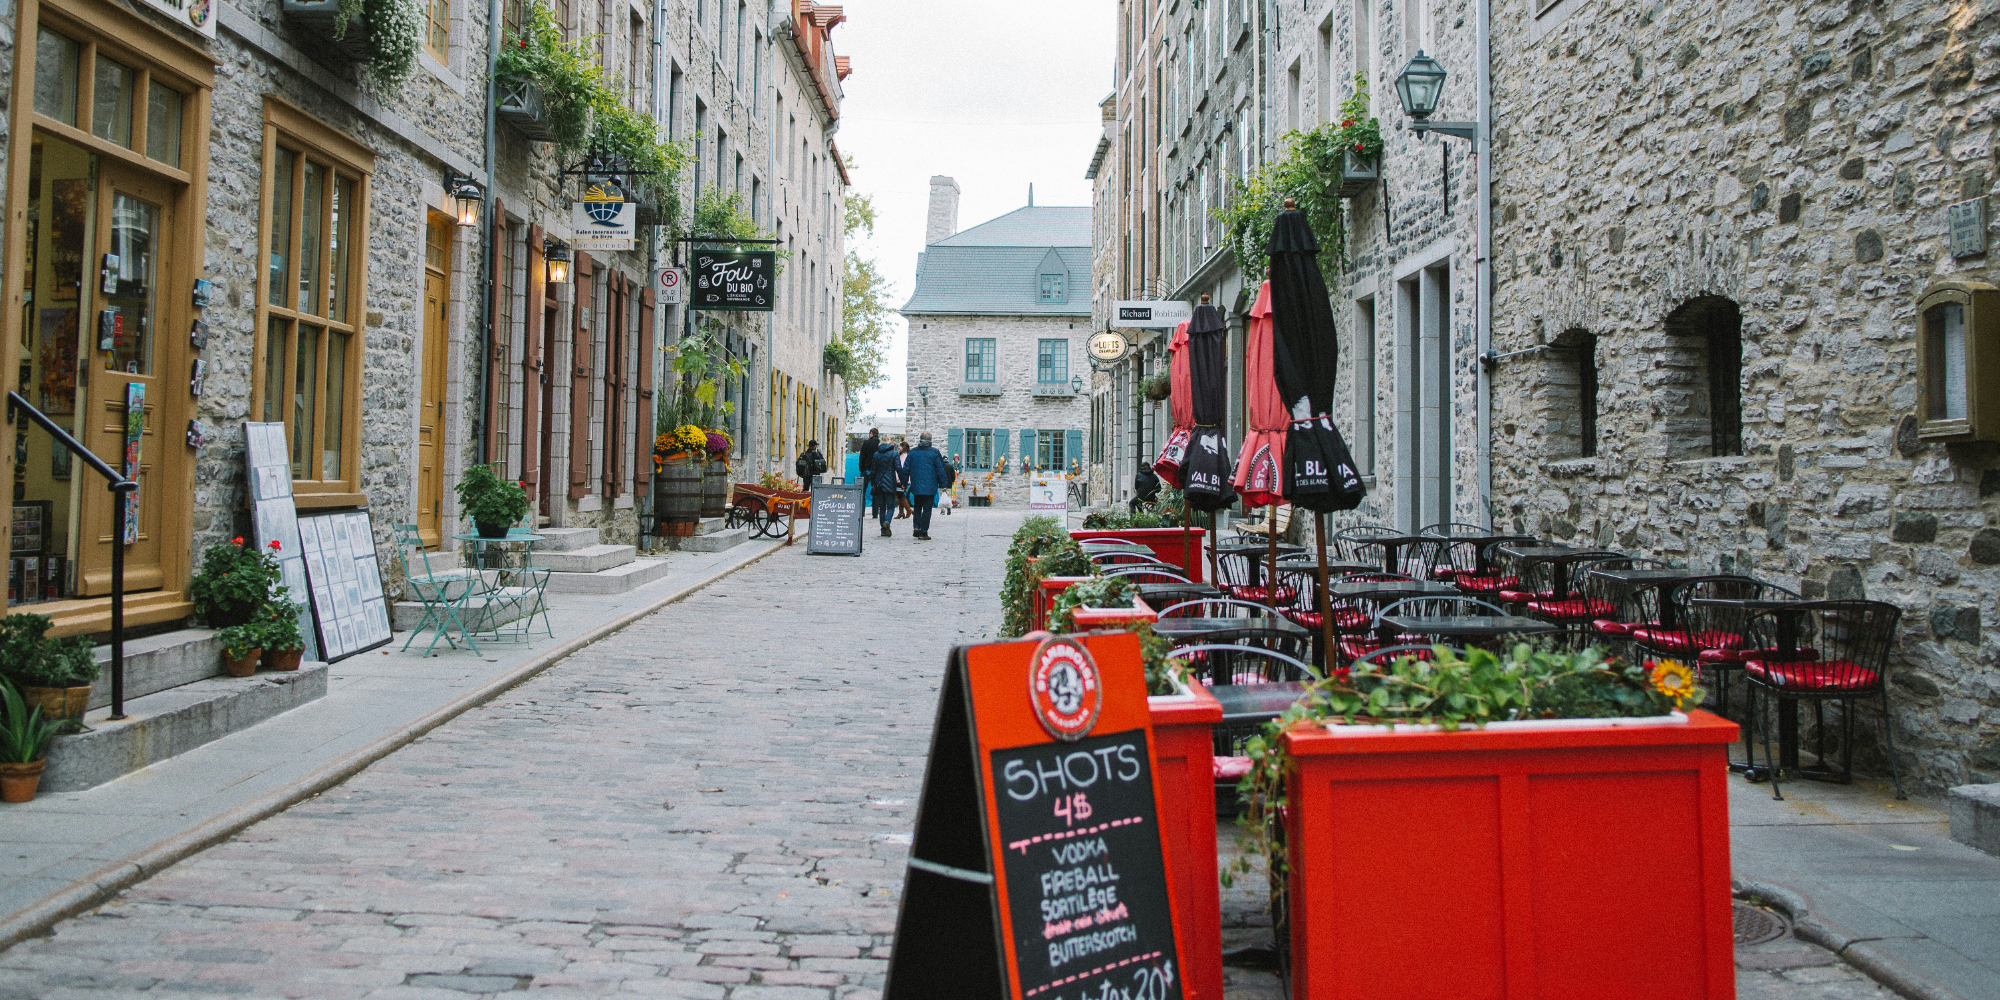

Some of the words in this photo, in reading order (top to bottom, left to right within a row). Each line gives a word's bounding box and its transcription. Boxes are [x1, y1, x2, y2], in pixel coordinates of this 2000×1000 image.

[712, 260, 753, 286] Fou
[726, 282, 738, 293] DU
[740, 283, 754, 293] BIO
[1122, 310, 1150, 318] Richard
[1154, 310, 1188, 318] Robitaille
[818, 500, 838, 510] Fou
[1004, 744, 1140, 800] SHOTS
[1054, 792, 1093, 827] 4$
[1052, 836, 1108, 865] VODKA
[1048, 924, 1138, 968] BUTTERSCOTCH
